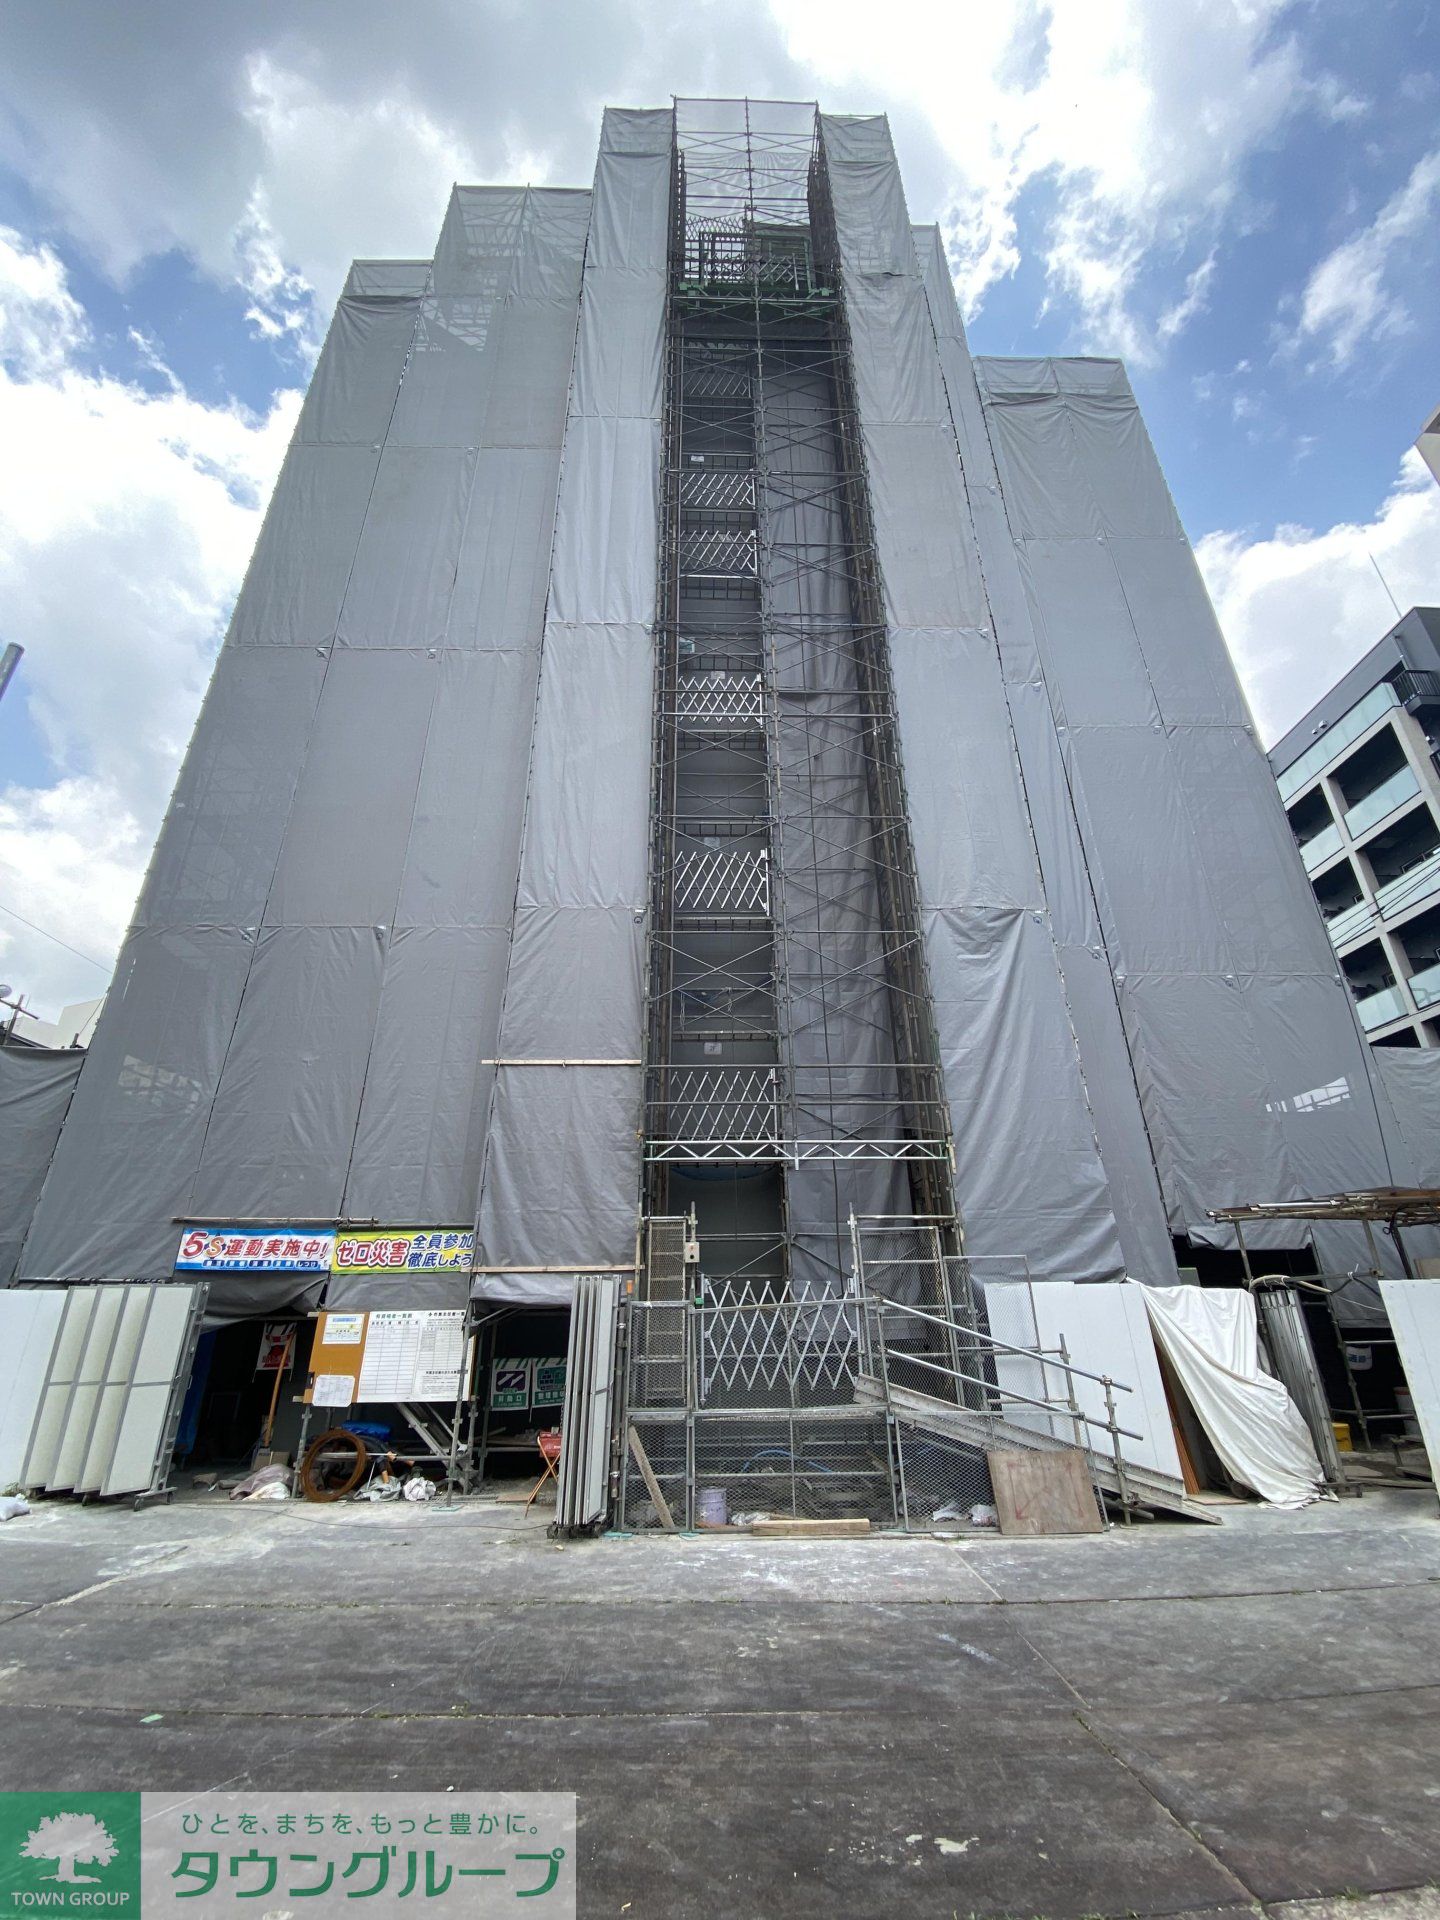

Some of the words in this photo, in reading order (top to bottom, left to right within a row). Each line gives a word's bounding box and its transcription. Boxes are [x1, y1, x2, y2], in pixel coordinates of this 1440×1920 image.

[411, 1234, 474, 1249] 全員参加
[338, 1240, 409, 1266] ゼロ災害
[408, 1252, 473, 1268] 徹底しよう
